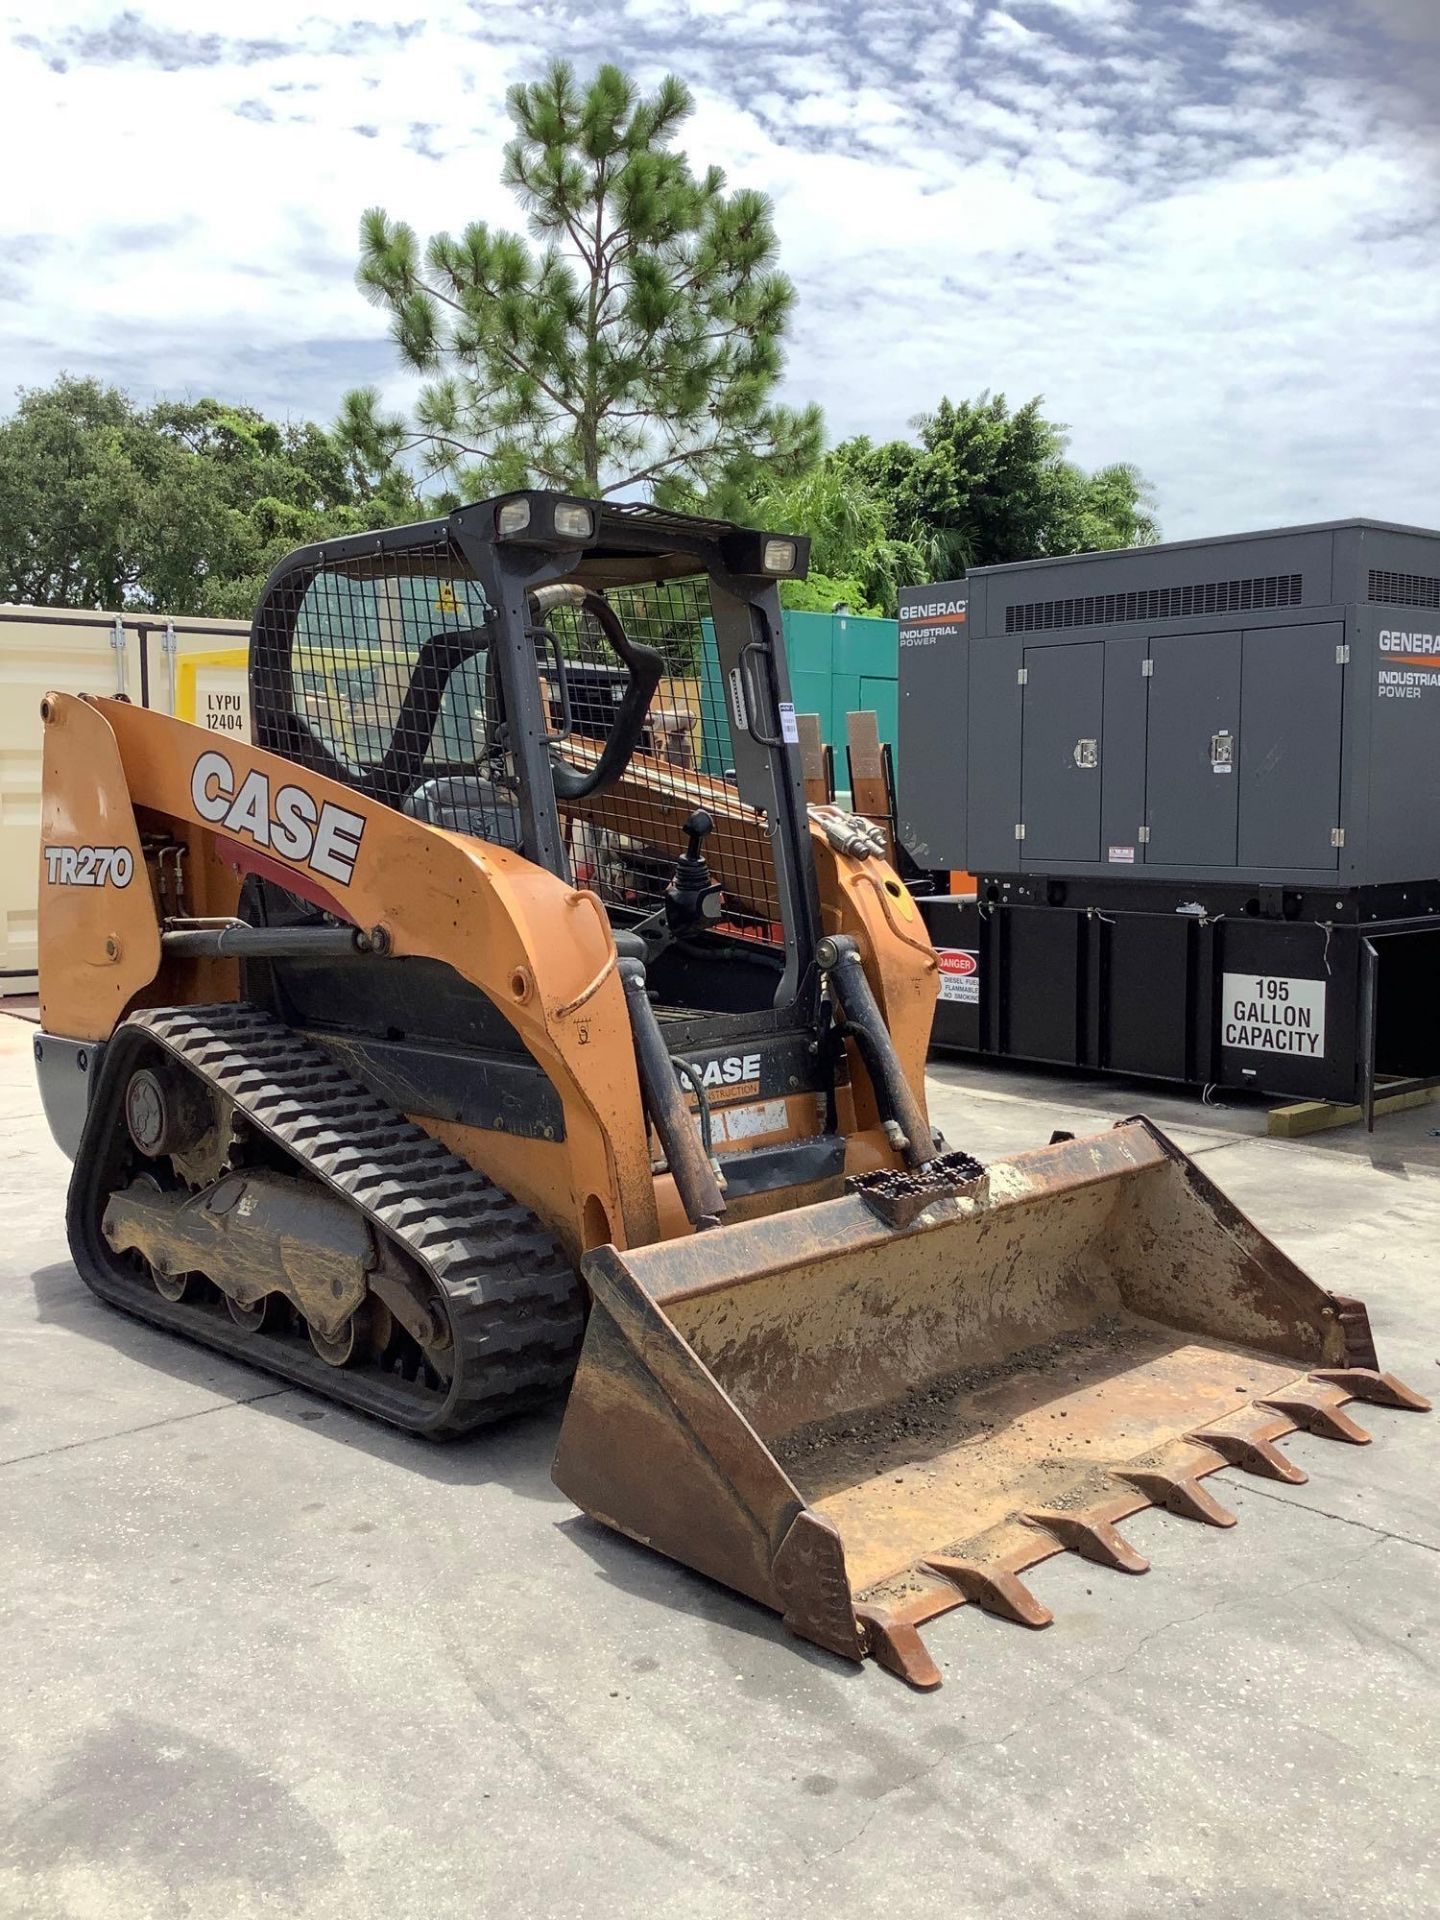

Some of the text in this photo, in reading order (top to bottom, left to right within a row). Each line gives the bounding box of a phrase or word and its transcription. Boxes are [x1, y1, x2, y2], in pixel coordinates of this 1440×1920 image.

[900, 600, 966, 620] GENERAC
[900, 626, 957, 640] INDUSTRIAL
[900, 637, 936, 647] POWER
[1379, 630, 1440, 654] GENERA
[1378, 686, 1421, 698] POWER
[208, 694, 241, 711] LYPU
[206, 713, 243, 730] 12404
[190, 750, 367, 887] CASE
[44, 846, 134, 889] TR270
[944, 977, 963, 985] DIESEL
[1256, 979, 1289, 1001] 195
[1234, 1001, 1311, 1028] GALLON
[1226, 1024, 1320, 1053] CAPACITY
[680, 1054, 761, 1090] CASE
[691, 1084, 757, 1104] CNSTRUCTION
